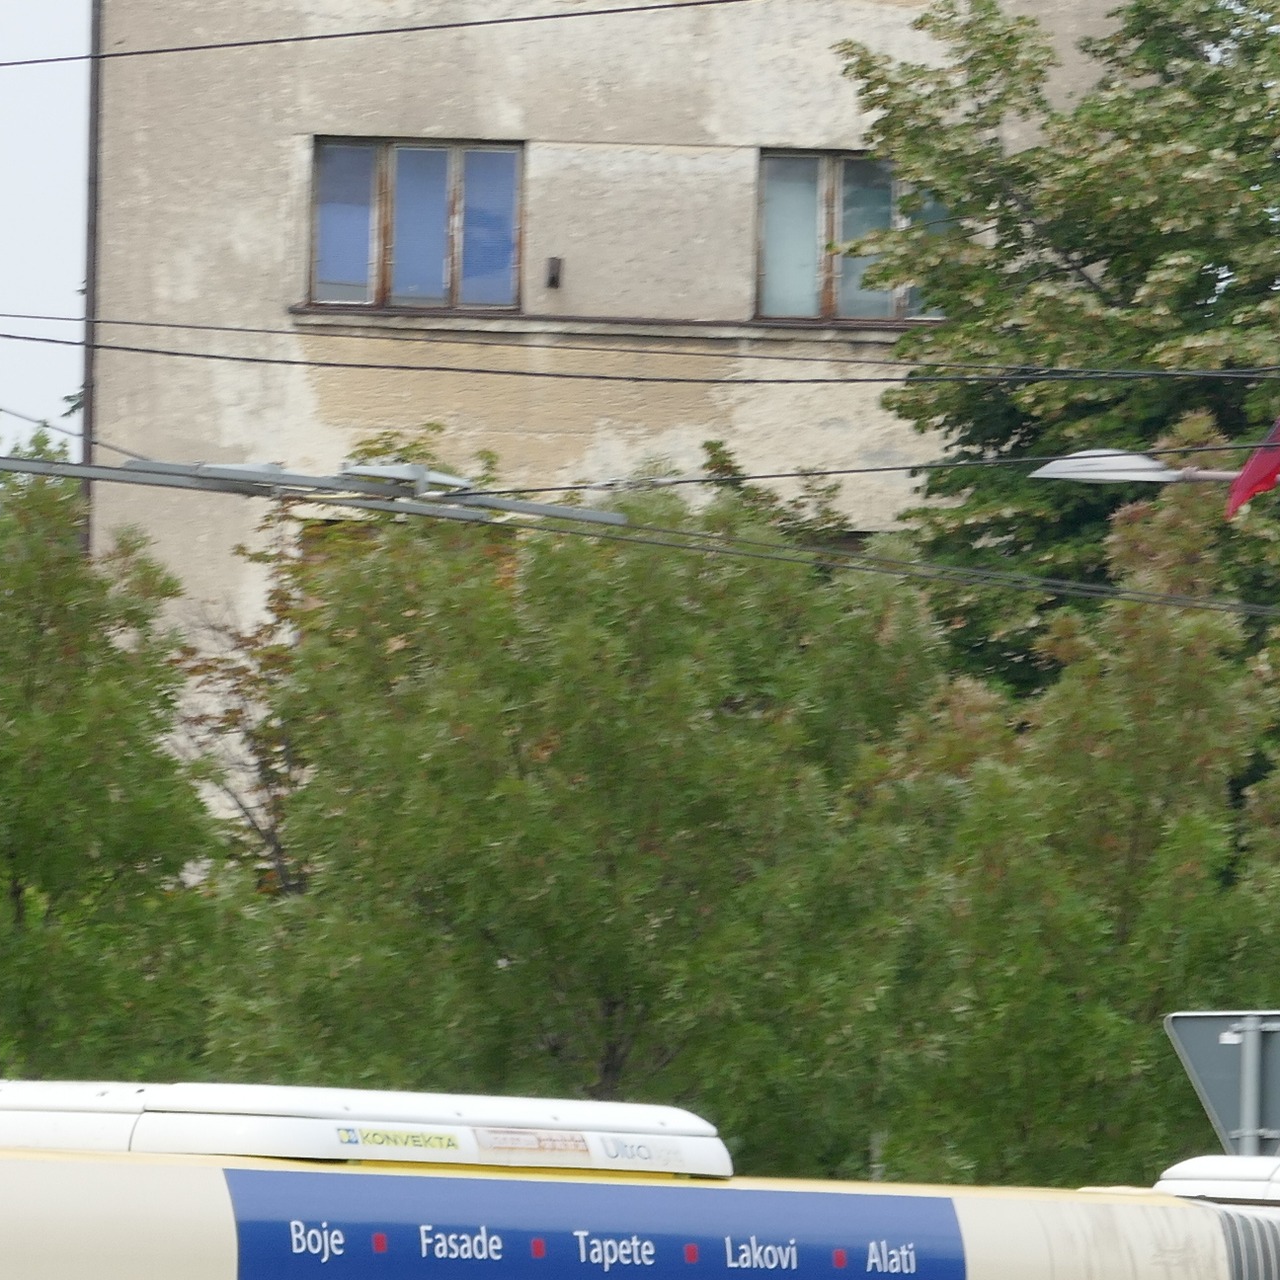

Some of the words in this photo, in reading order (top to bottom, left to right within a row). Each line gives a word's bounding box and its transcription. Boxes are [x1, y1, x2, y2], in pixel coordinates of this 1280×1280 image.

[360, 1129, 459, 1151] KONVEKTA
[289, 1220, 346, 1264] Boje
[419, 1224, 503, 1261] Fasade
[573, 1230, 656, 1273] Tapete
[724, 1235, 799, 1271] Lakovi
[866, 1240, 917, 1275] Alati
